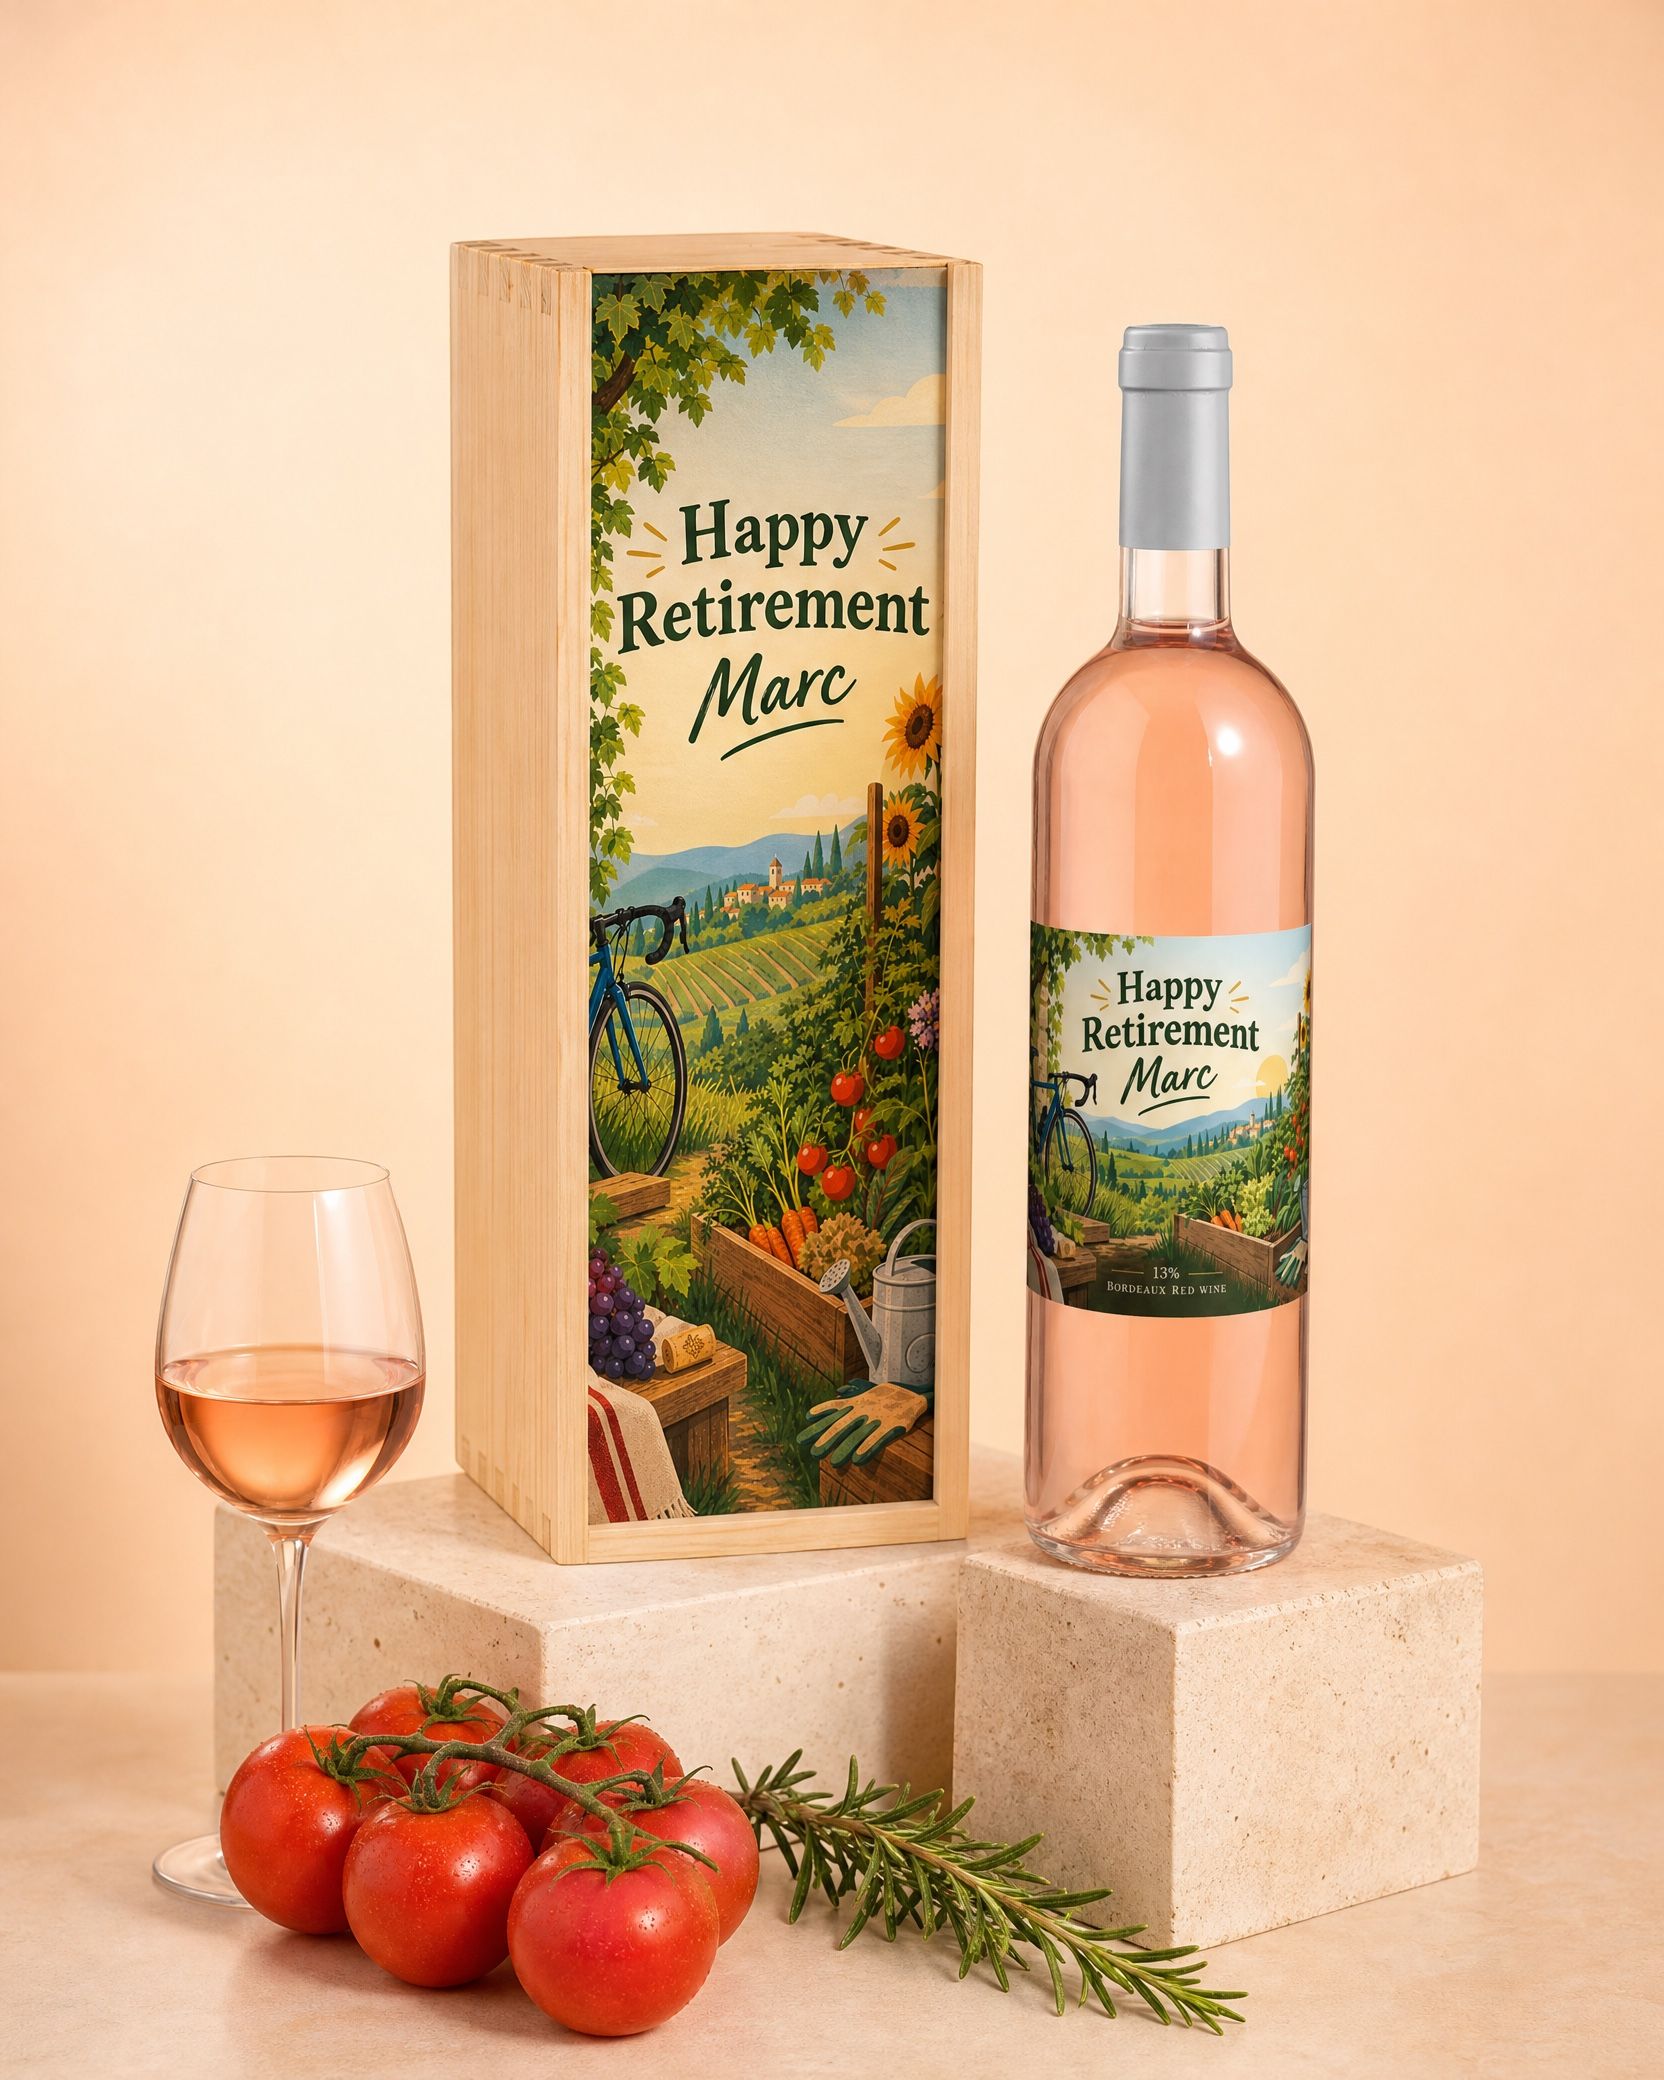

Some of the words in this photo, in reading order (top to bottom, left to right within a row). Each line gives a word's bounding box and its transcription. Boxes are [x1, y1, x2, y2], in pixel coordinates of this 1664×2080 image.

[679, 499, 869, 569] Happy
[616, 579, 930, 654] Retirement
[688, 653, 857, 744] Marc
[1117, 970, 1223, 1012] Happy
[1082, 1013, 1260, 1053] Retirement
[1121, 1055, 1218, 1105] Marc
[1153, 1266, 1180, 1280] 13%
